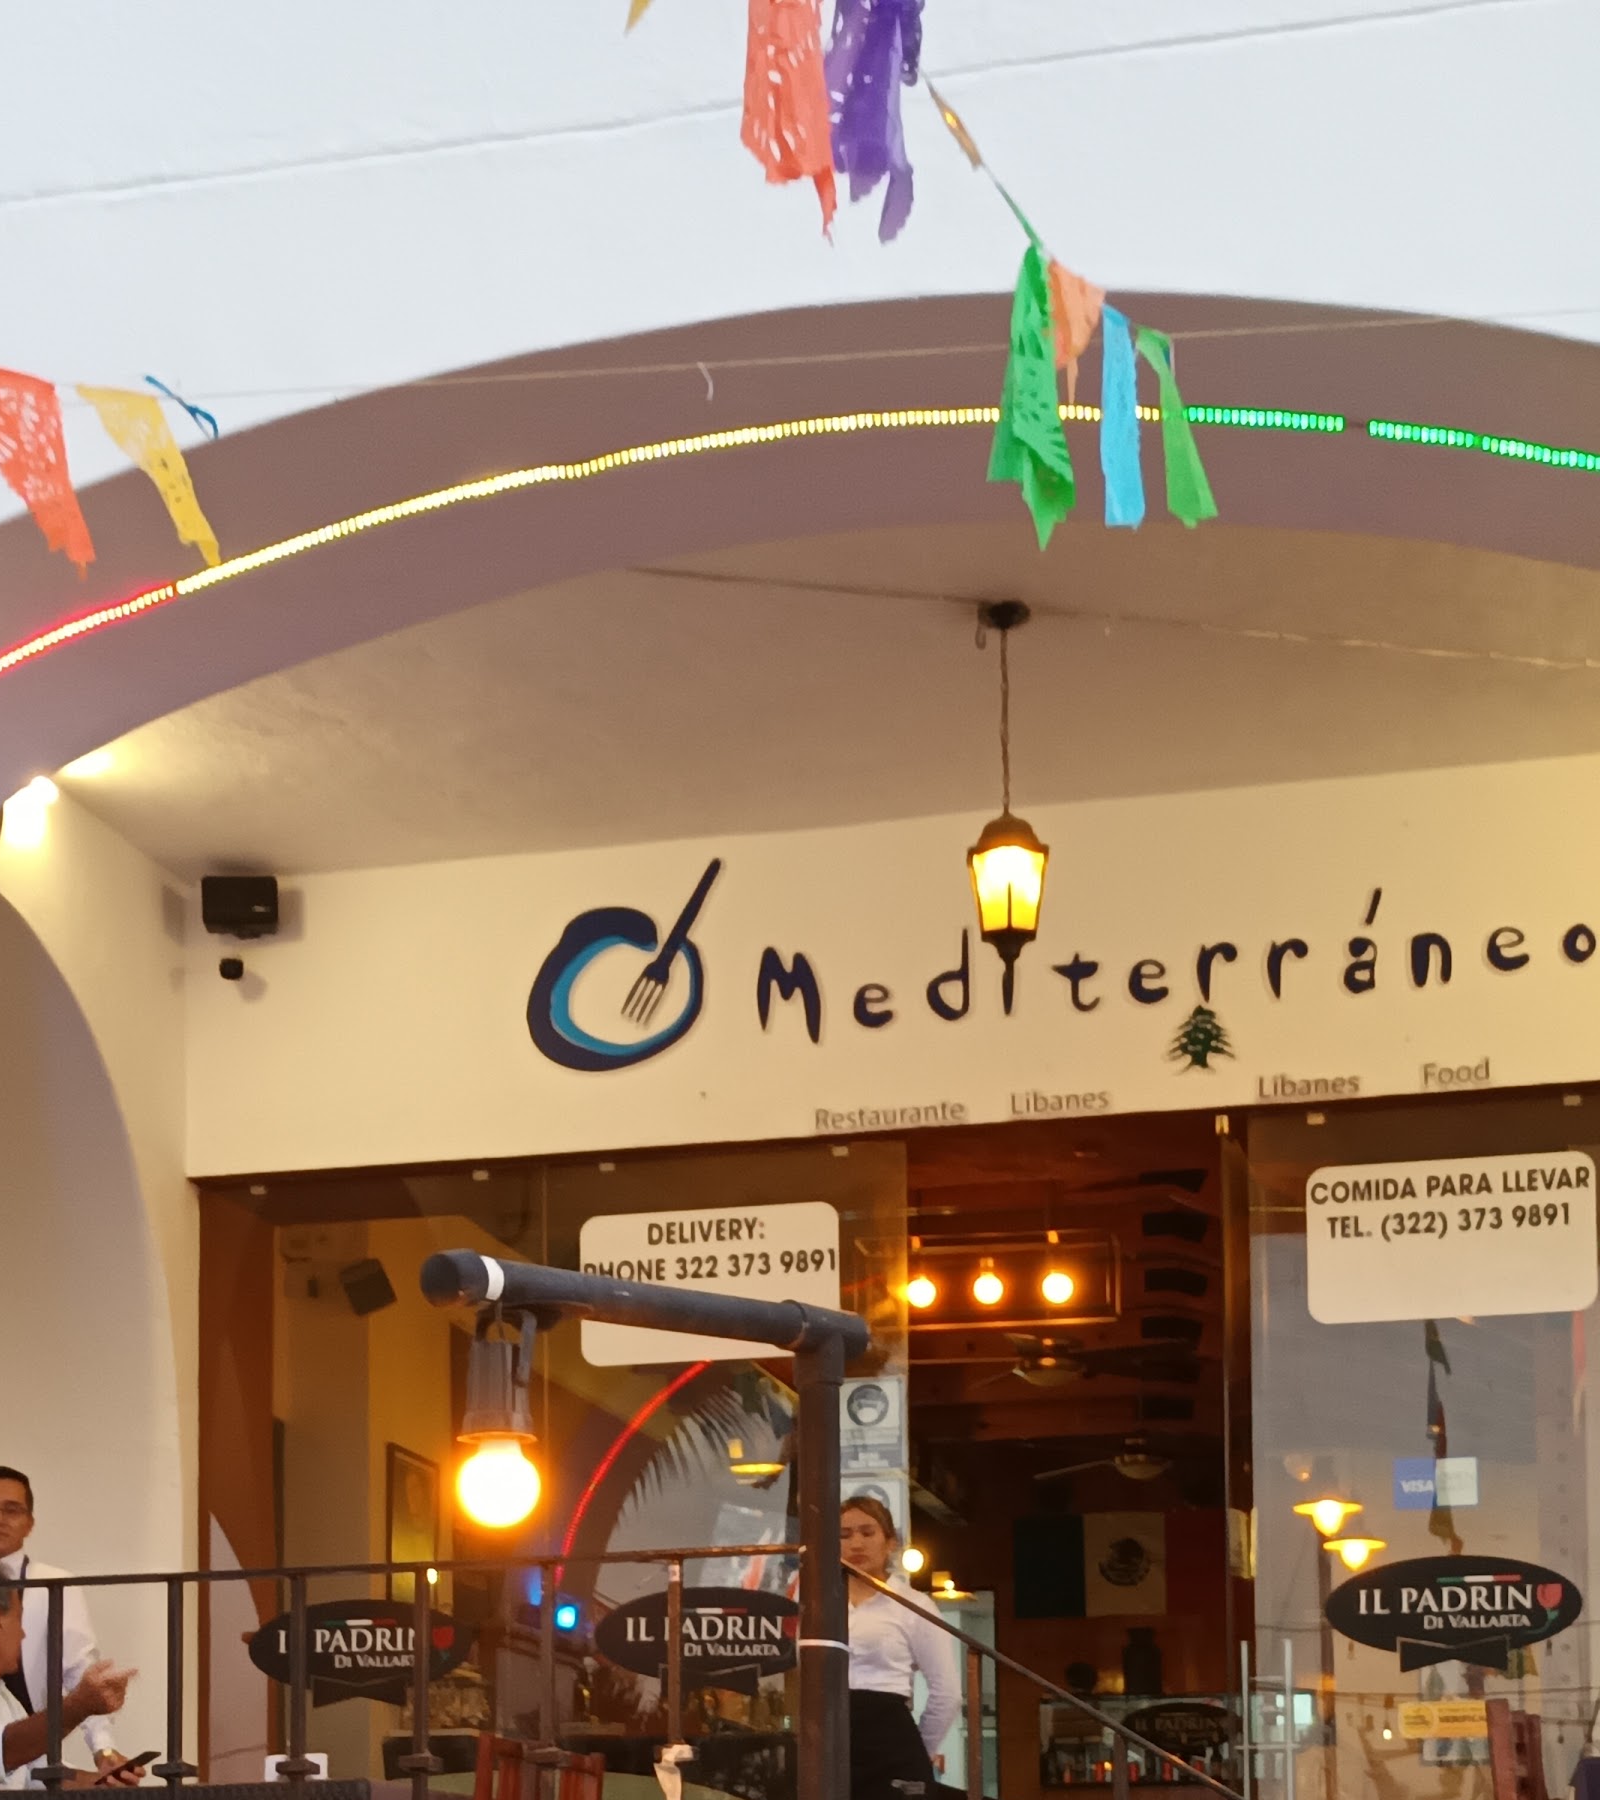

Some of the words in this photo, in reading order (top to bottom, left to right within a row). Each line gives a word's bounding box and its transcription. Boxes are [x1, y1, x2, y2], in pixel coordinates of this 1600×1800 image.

[756, 886, 1597, 1045] Mediterráneo
[1257, 1073, 1361, 1099] Libanes
[1422, 1056, 1491, 1087] Food
[814, 1101, 966, 1131] Restaurante
[1010, 1088, 1111, 1116] Libanes
[1309, 1177, 1418, 1205] COMIDA
[1426, 1172, 1493, 1198] PARA
[1502, 1165, 1591, 1194] LLEVAR
[646, 1216, 767, 1246] DELIVERY:
[1326, 1215, 1374, 1240] TEL.
[1380, 1210, 1449, 1243] (322)
[1457, 1206, 1503, 1232] 373
[1511, 1202, 1571, 1228] 9891
[674, 1254, 720, 1281] 322
[727, 1251, 772, 1278] 373
[779, 1247, 837, 1274] 9891
[1399, 1479, 1434, 1494] VISA
[1357, 1588, 1392, 1616] IL
[1400, 1583, 1534, 1615] PADRIN
[625, 1616, 656, 1643] IL
